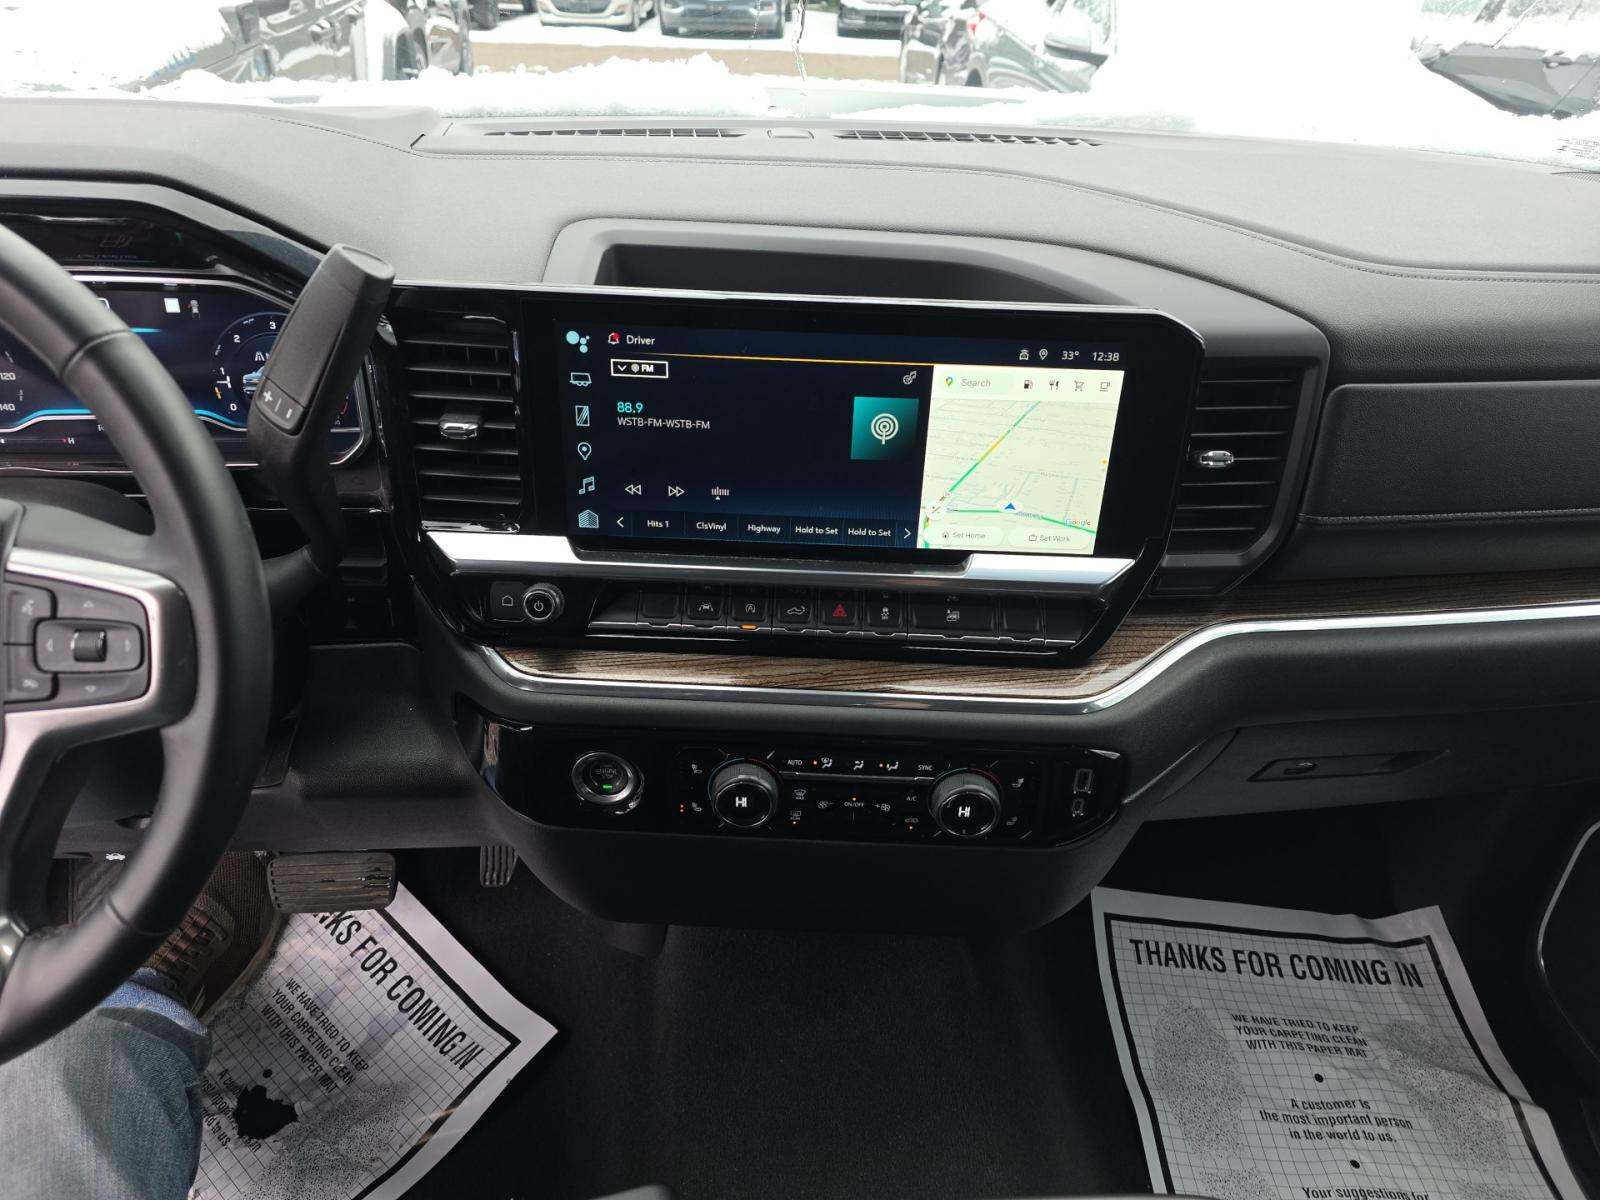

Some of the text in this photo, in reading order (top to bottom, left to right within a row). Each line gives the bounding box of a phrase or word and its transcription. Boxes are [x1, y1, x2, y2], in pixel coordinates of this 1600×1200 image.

[269, 321, 277, 330] 3
[233, 335, 241, 343] 2
[626, 334, 656, 345] Driver
[1061, 350, 1080, 361] 33°
[1092, 351, 1120, 362] 12:38
[641, 364, 654, 373] FM
[960, 378, 991, 388] Search
[230, 403, 237, 411] 0
[617, 401, 644, 414] 88.9
[617, 416, 711, 430] WSTB-FM-WSTB-FM
[67, 437, 75, 445] H
[647, 520, 663, 528] Hits
[696, 522, 727, 532] ClsVinyl
[1064, 518, 1091, 528] Google
[747, 524, 781, 535] Highway
[795, 526, 814, 534] Hold
[825, 527, 839, 535] Set
[848, 528, 866, 536] Hold
[878, 529, 891, 537] Set
[966, 532, 986, 540] Home
[1039, 535, 1071, 543] Set Work
[735, 796, 748, 808] HI
[958, 806, 971, 818] HI
[1129, 938, 1424, 988] THANKS FOR COMING IN
[350, 936, 398, 986] FOR
[386, 975, 467, 1056] COMING
[450, 1041, 485, 1071] IN
[272, 989, 294, 1014] YOUR
[291, 1011, 332, 1059] CARPETING
[285, 977, 369, 1071] WE HAVE TRIED TO KEEP
[1231, 1013, 1359, 1034] WE HAVE TRIED TO KEEP
[1234, 1025, 1368, 1047] YOUR CARPETING CLEAN
[261, 1004, 337, 1094] WITH THIS PAPER MAT
[1245, 1039, 1367, 1058] WITH THIS PAPER MAT
[1290, 1098, 1371, 1111] A customer is
[1259, 1110, 1413, 1130] the most important person
[1288, 1127, 1397, 1143] in the world to us.
[1302, 1187, 1332, 1199] Your
[1335, 1187, 1410, 1200] suggestions
